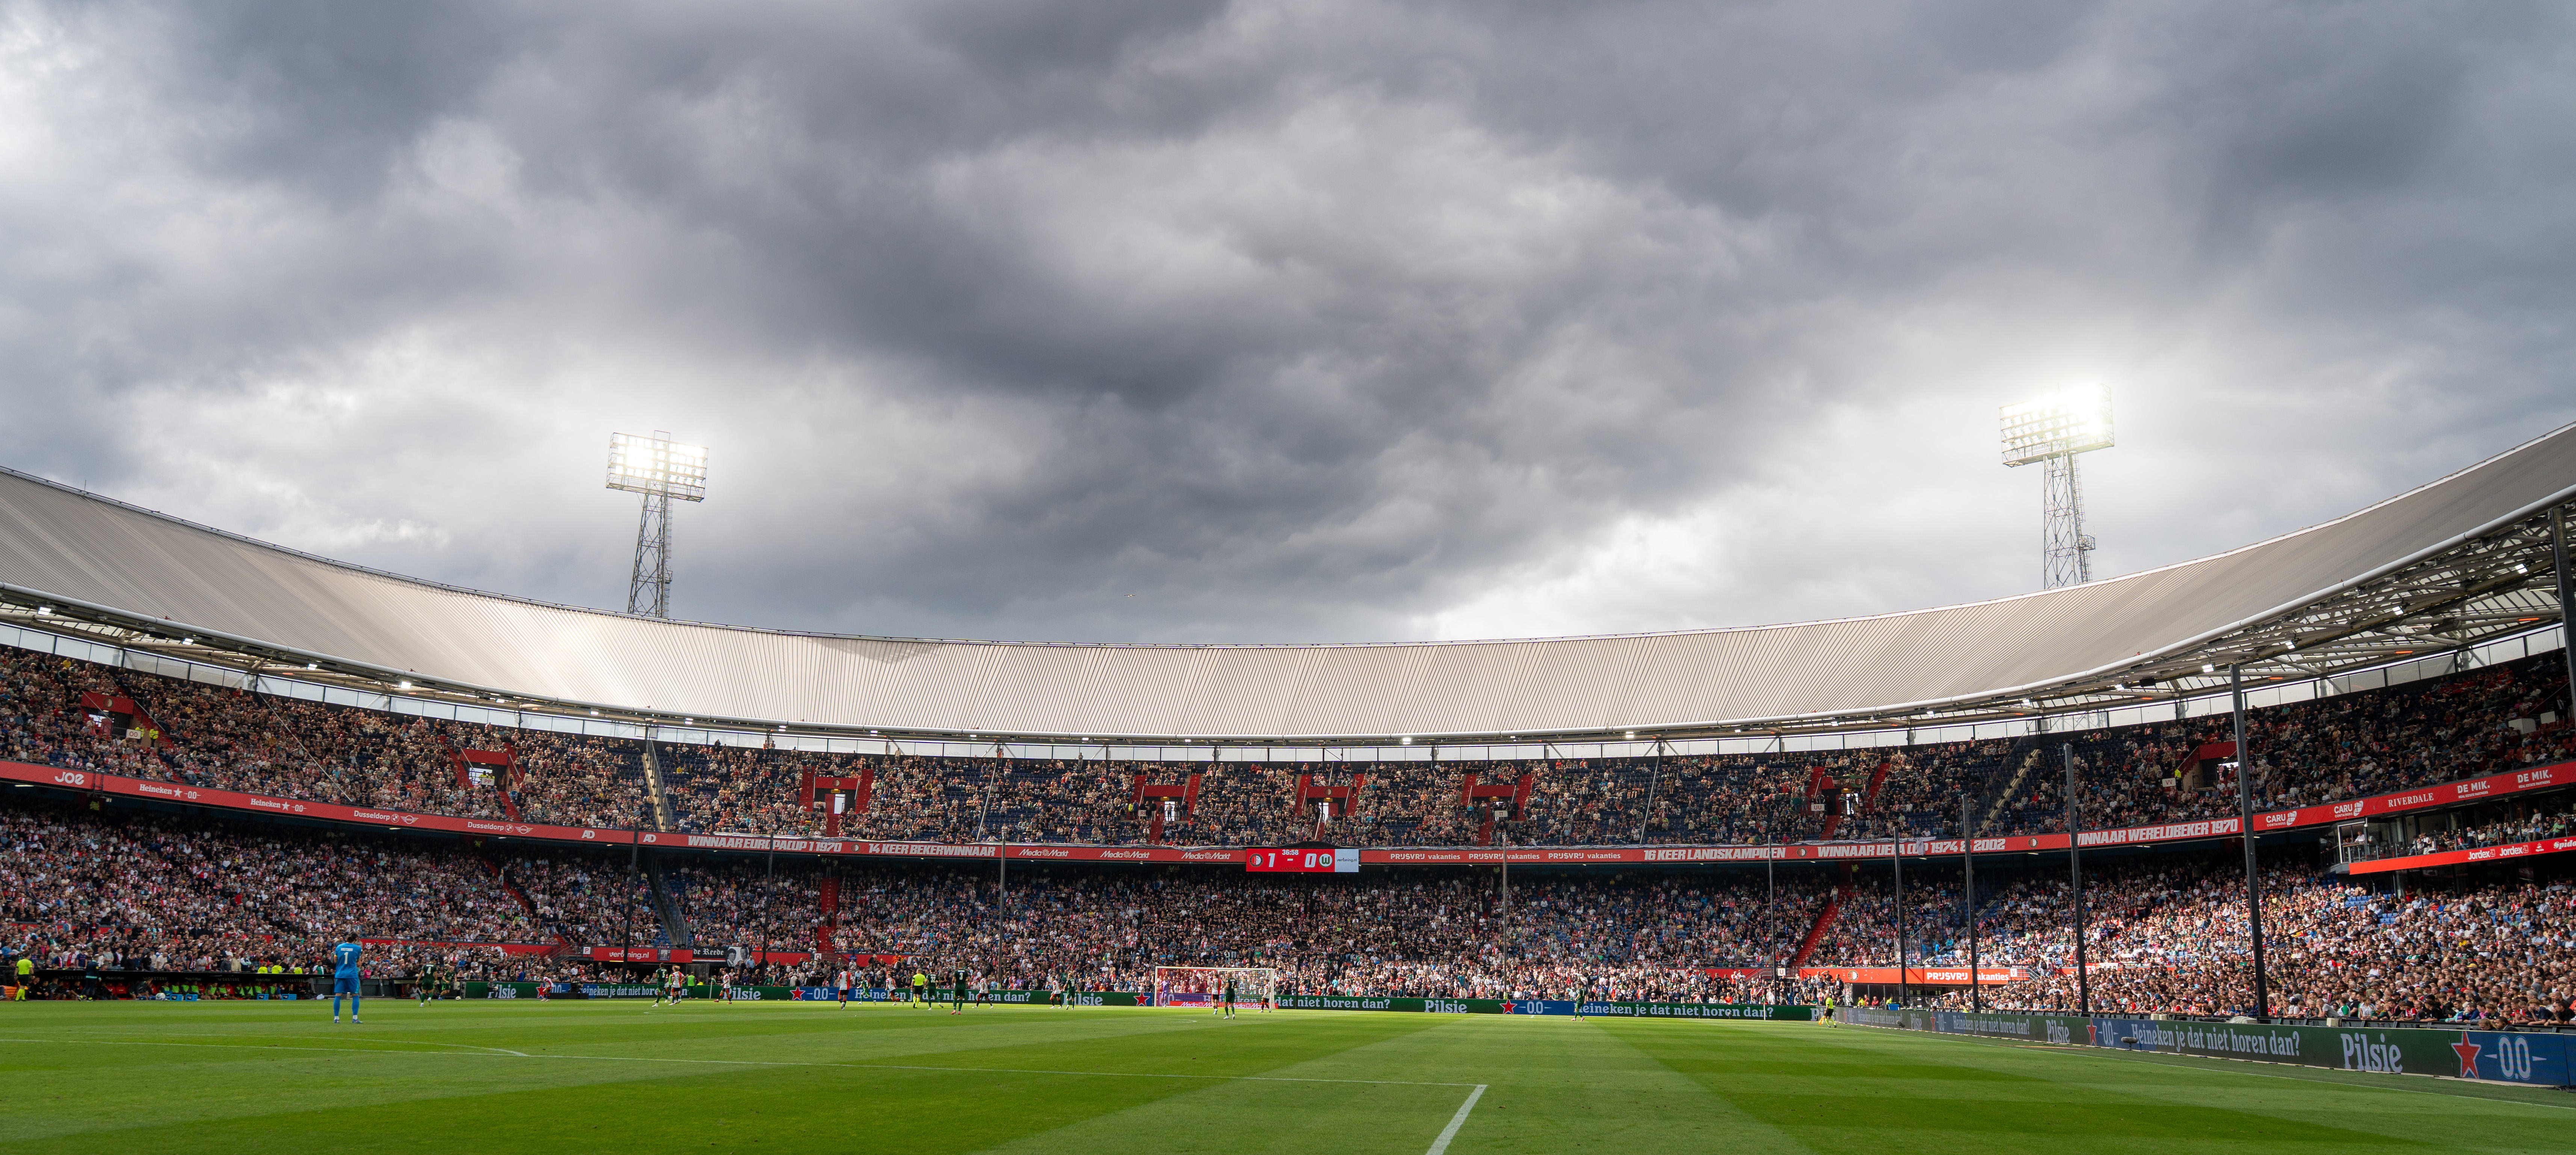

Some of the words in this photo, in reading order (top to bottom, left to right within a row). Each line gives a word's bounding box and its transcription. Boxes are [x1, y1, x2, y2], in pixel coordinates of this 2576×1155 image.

[54, 771, 84, 785] JOE
[2517, 774, 2528, 783] DE
[2532, 769, 2552, 780] MIK.
[139, 784, 172, 795] Heineken
[2457, 785, 2468, 794] DE
[2471, 781, 2490, 791] MIK.
[251, 798, 281, 808] Heineken
[2388, 793, 2434, 807] RIVERDALE
[2334, 804, 2352, 814] CARU
[354, 810, 390, 821] Dusseldorp
[2266, 814, 2286, 823] CARU
[468, 821, 504, 832] Dusseldorp
[2128, 821, 2209, 842] WERELDBEKER
[2211, 819, 2238, 833] 1970
[581, 830, 595, 839] AD
[643, 834, 656, 842] AD
[688, 836, 742, 848] WINNAAR
[814, 842, 842, 852] 1970
[868, 844, 879, 853] 14
[882, 844, 909, 854] KEER
[910, 845, 996, 856] BEKERWINNAAR
[1818, 845, 1875, 857] WINNAAR
[1931, 841, 1958, 853] 1974
[1974, 839, 2006, 851] 2002
[1048, 849, 1069, 857] Markt
[1644, 850, 1655, 860] 16
[1657, 849, 1686, 861] KEER
[1687, 847, 1786, 860] LANDSKAMPIOEN
[2468, 850, 2490, 860] Jordex
[2500, 846, 2523, 856] Jordex
[1268, 853, 1275, 867] 1
[1305, 853, 1317, 867] 0
[344, 952, 349, 964] 1
[1977, 972, 2009, 981] akanties
[582, 986, 609, 996] eineken
[609, 986, 615, 998] je
[617, 986, 627, 996] dat
[628, 986, 641, 996] niet
[1004, 992, 1031, 1002] dan?
[1298, 997, 1320, 1007] niet
[1323, 998, 1359, 1008] horen
[1362, 999, 1390, 1009] dan?
[1424, 1000, 1467, 1013] Pilsie
[1634, 1004, 1646, 1017] je
[1650, 1005, 1670, 1015] dat
[1673, 1005, 1699, 1016] niet
[1702, 1006, 1740, 1017] horen
[1744, 1007, 1774, 1018] dan?
[1910, 1013, 1922, 1030] Pilsie
[1953, 1015, 1974, 1030] Heineken
[1974, 1016, 1979, 1034] je
[1989, 1016, 1999, 1033] niet
[2000, 1018, 2016, 1034] horen
[2016, 1018, 2030, 1035] dan?
[2046, 1020, 2070, 1043] Pilsie
[2132, 1024, 2175, 1046] Heineken
[2176, 1025, 2185, 1052] je
[2188, 1027, 2205, 1049] dat
[2207, 1028, 2229, 1051] niet
[2231, 1028, 2267, 1054] horen
[2269, 1030, 2300, 1056] dan?
[2340, 1033, 2403, 1073] Pilsie
